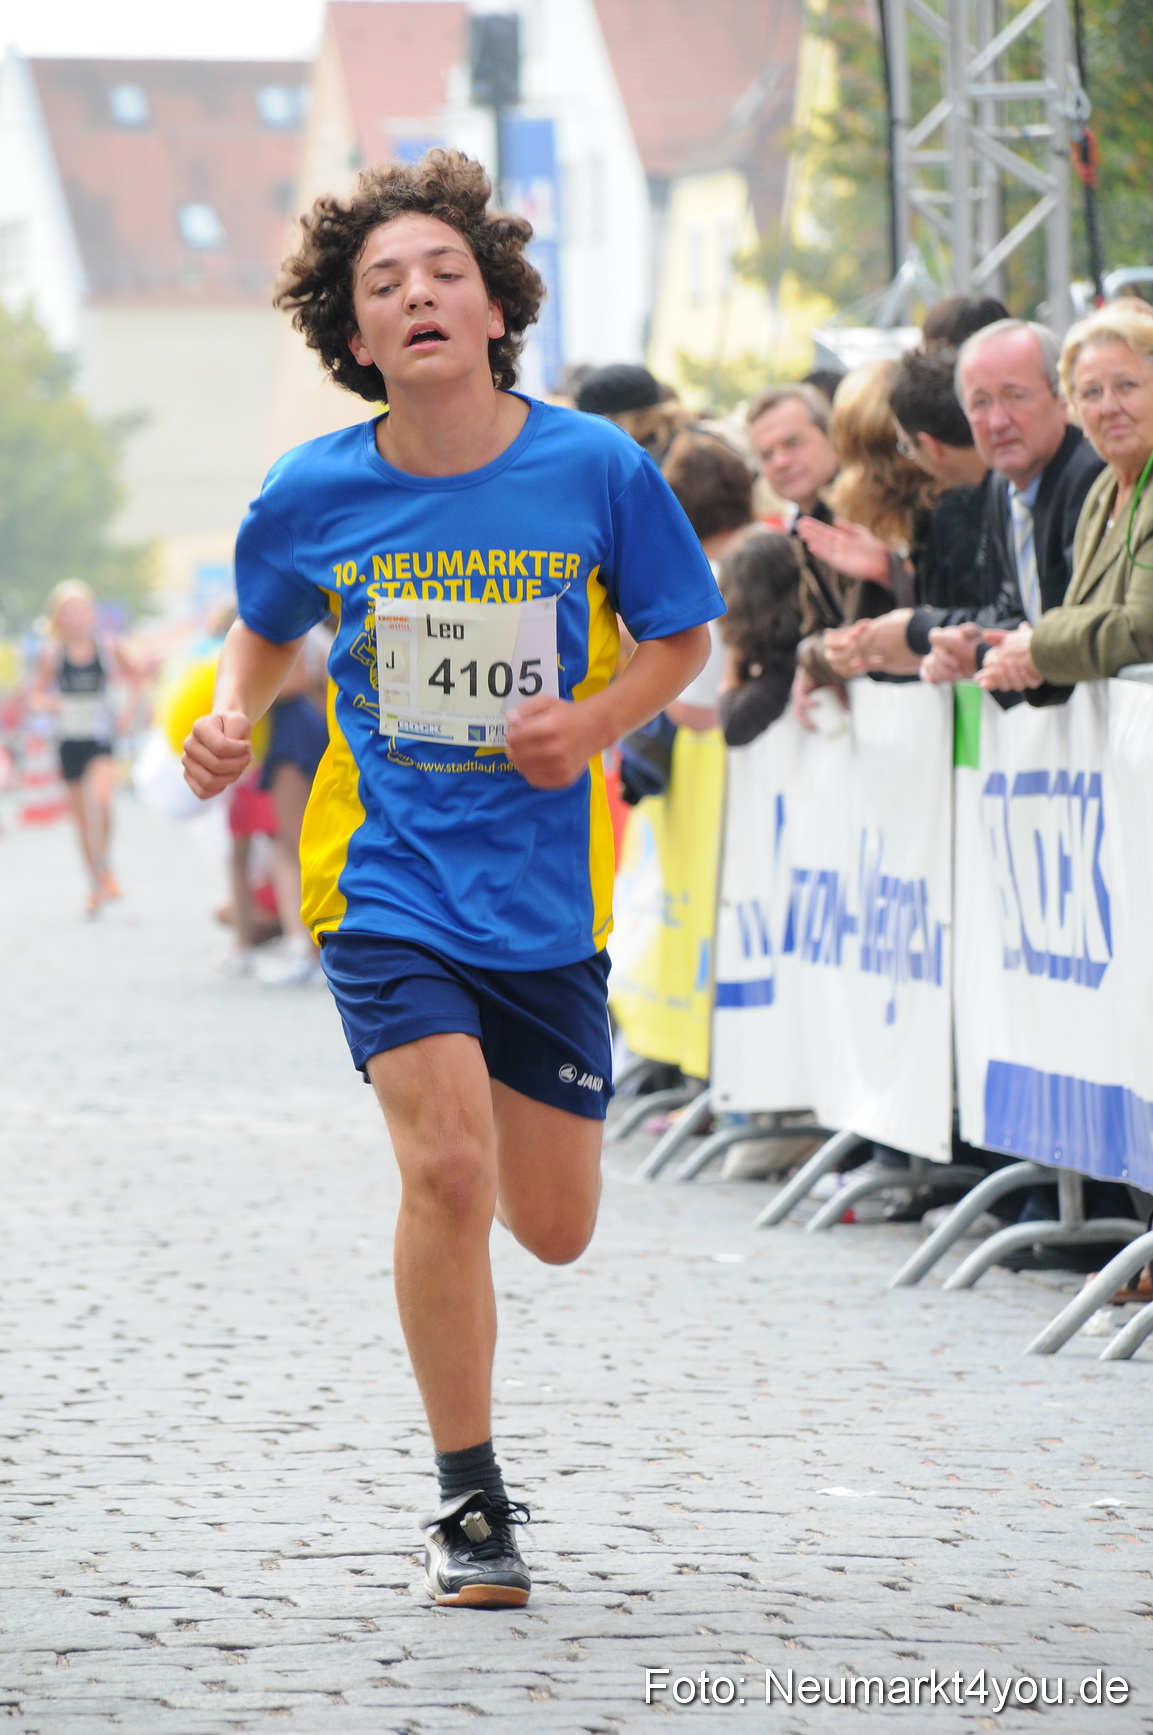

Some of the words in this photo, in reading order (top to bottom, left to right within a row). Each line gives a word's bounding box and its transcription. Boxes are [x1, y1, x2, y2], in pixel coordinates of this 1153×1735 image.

[333, 560, 367, 588] 10.
[372, 549, 581, 580] NEUMARKTER
[366, 578, 542, 606] STADTLAUF
[426, 613, 465, 640] Leo
[385, 650, 395, 669] J
[428, 658, 543, 698] 4105
[577, 1072, 604, 1092] JAKO
